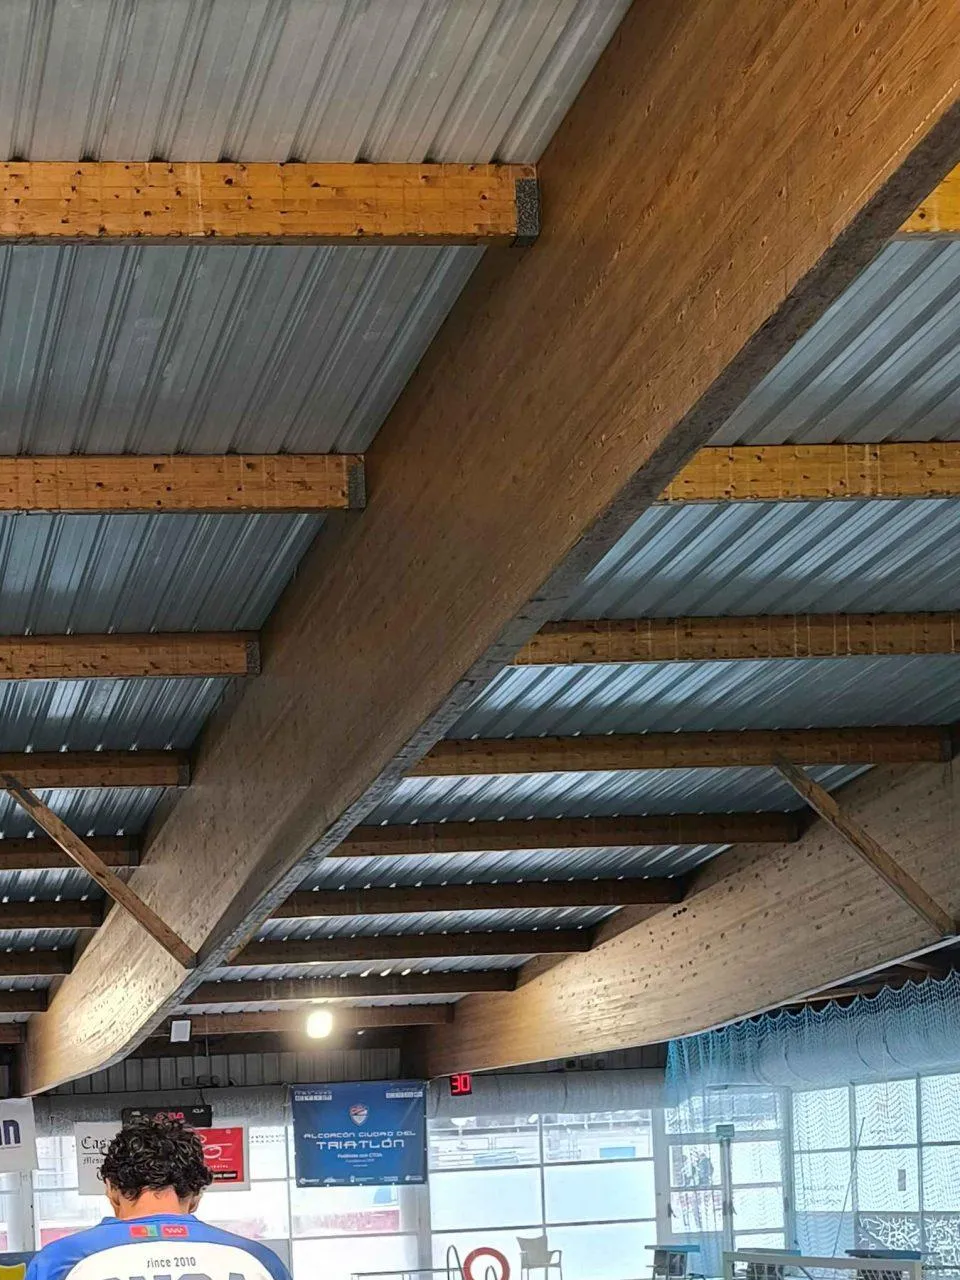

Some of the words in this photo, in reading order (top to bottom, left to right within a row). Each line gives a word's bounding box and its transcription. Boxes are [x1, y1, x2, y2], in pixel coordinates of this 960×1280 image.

[451, 1074, 470, 1092] 30
[316, 1138, 405, 1150] TRIATLÓN
[146, 1257, 171, 1268] since
[174, 1256, 196, 1267] 2010
